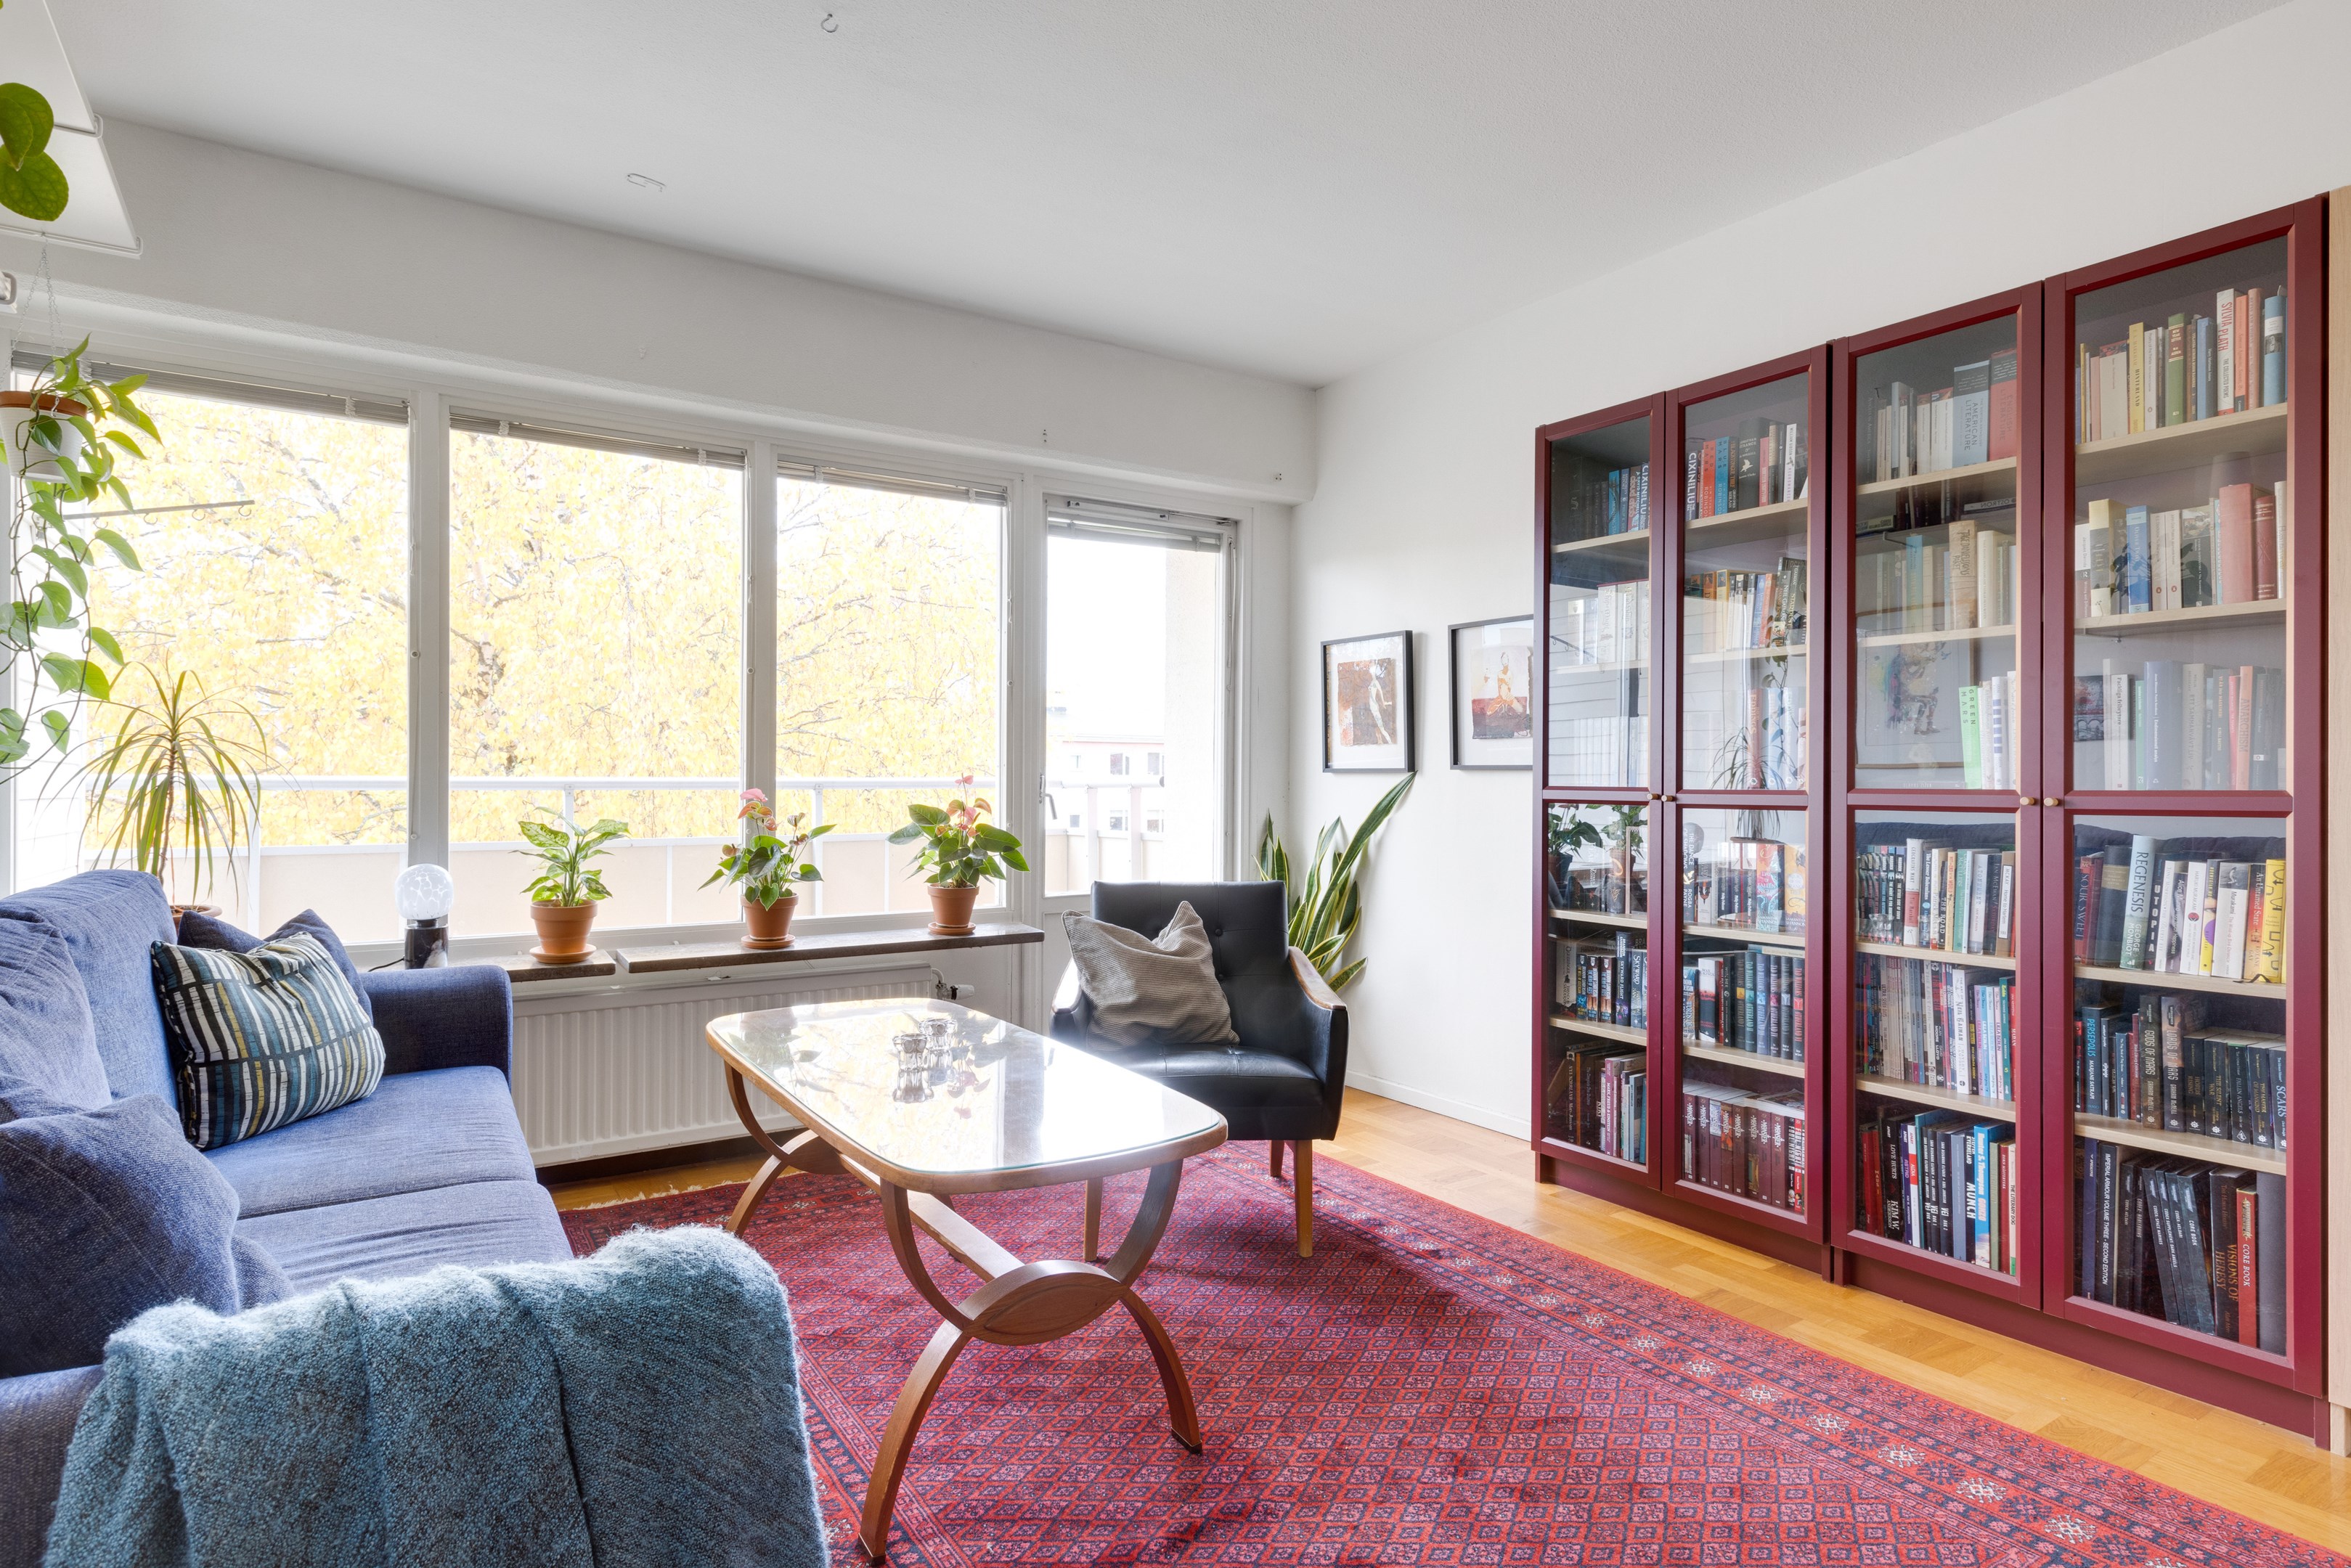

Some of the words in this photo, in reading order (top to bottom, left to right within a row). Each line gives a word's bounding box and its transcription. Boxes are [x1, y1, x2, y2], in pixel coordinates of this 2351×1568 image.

[2221, 302, 2233, 327] SYLVIA
[2218, 329, 2228, 351] PLATH
[1688, 452, 1697, 482] CIXIN
[2239, 698, 2249, 752] ANARCHISM
[2078, 874, 2090, 902] SOUR
[2131, 852, 2148, 912] REGENESIS
[2256, 872, 2264, 881] An
[2254, 883, 2263, 910] Untamed
[2076, 906, 2087, 937] SWEET
[2126, 923, 2135, 956] MONBIOT
[2132, 923, 2142, 952] GEORGE
[2087, 1018, 2096, 1056] PERSEPOLIS
[2144, 1030, 2155, 1046] GODS
[2167, 1030, 2177, 1051] LORDS
[2145, 1057, 2156, 1075] MARS
[2167, 1052, 2177, 1061] OF
[2167, 1063, 2179, 1080] MARS
[2276, 1085, 2286, 1117] SCARS
[1976, 1162, 1985, 1195] Thompson
[1966, 1183, 1976, 1219] MUNCH
[1978, 1198, 1987, 1221] GONZO
[1892, 1220, 1899, 1230] W.
[2214, 1250, 2226, 1290] HERESY
[2227, 1244, 2236, 1286] VISIONS
[2228, 1286, 2238, 1302] OF
